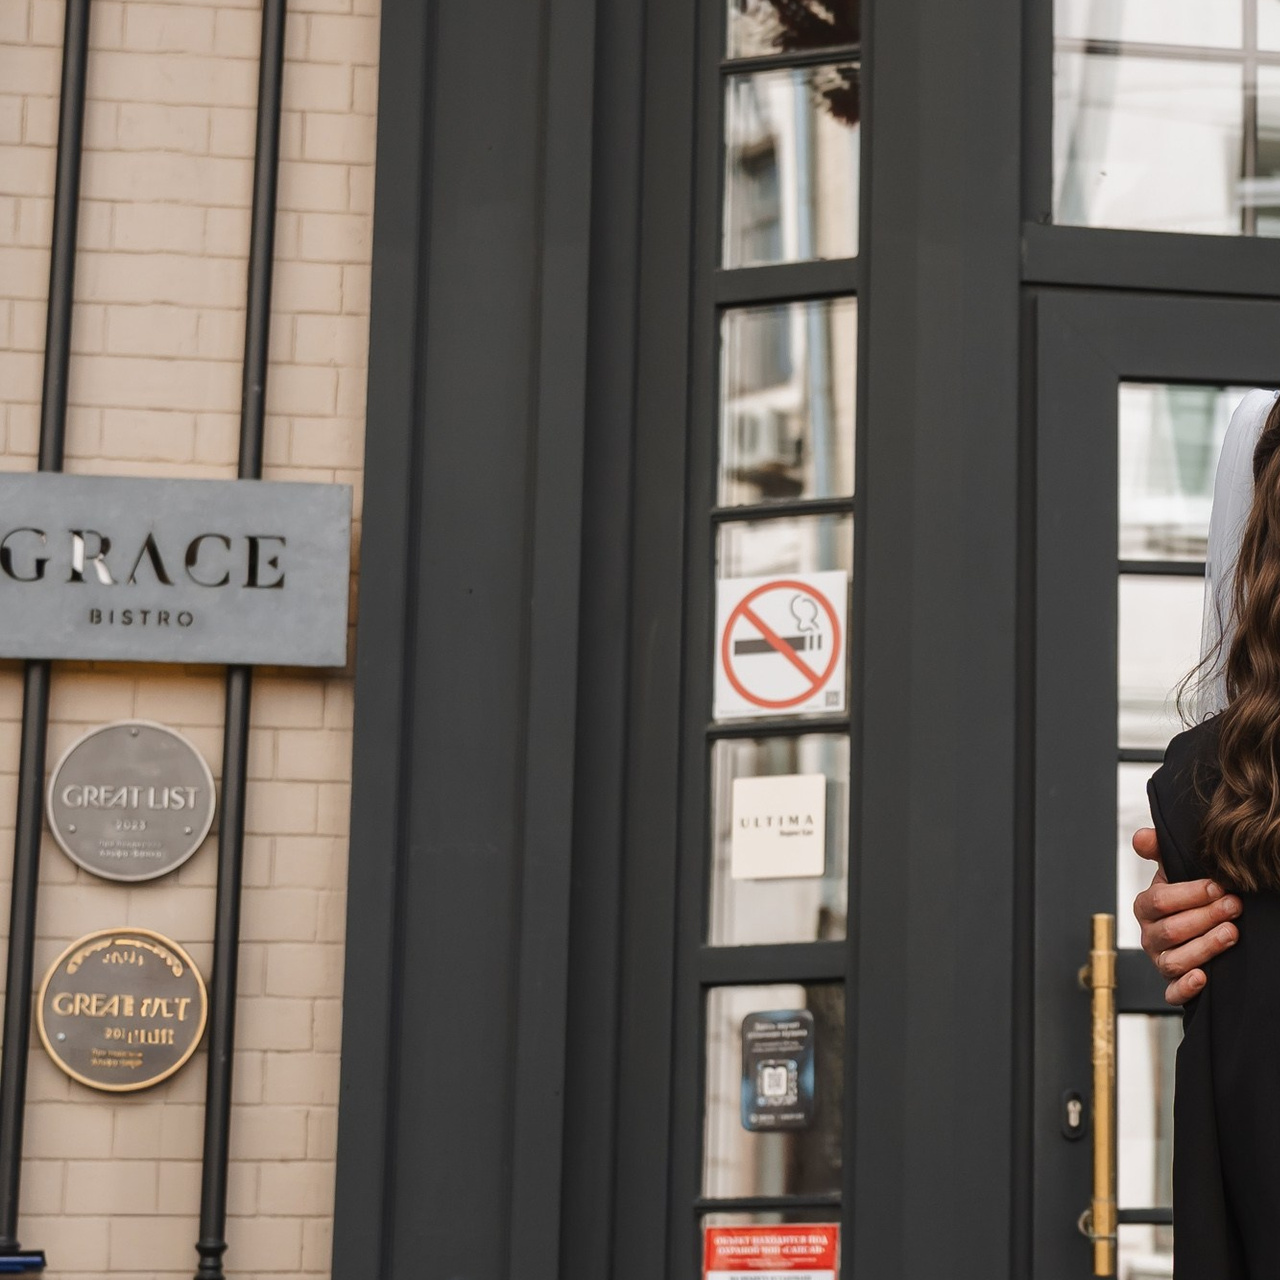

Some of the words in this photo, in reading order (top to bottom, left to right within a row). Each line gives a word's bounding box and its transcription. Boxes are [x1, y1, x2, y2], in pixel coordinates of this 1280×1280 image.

[0, 526, 287, 589] GRACE
[89, 608, 195, 628] BISTRO
[61, 784, 142, 810] GREAT
[147, 786, 200, 811] LIST
[740, 814, 814, 829] ULTIMA
